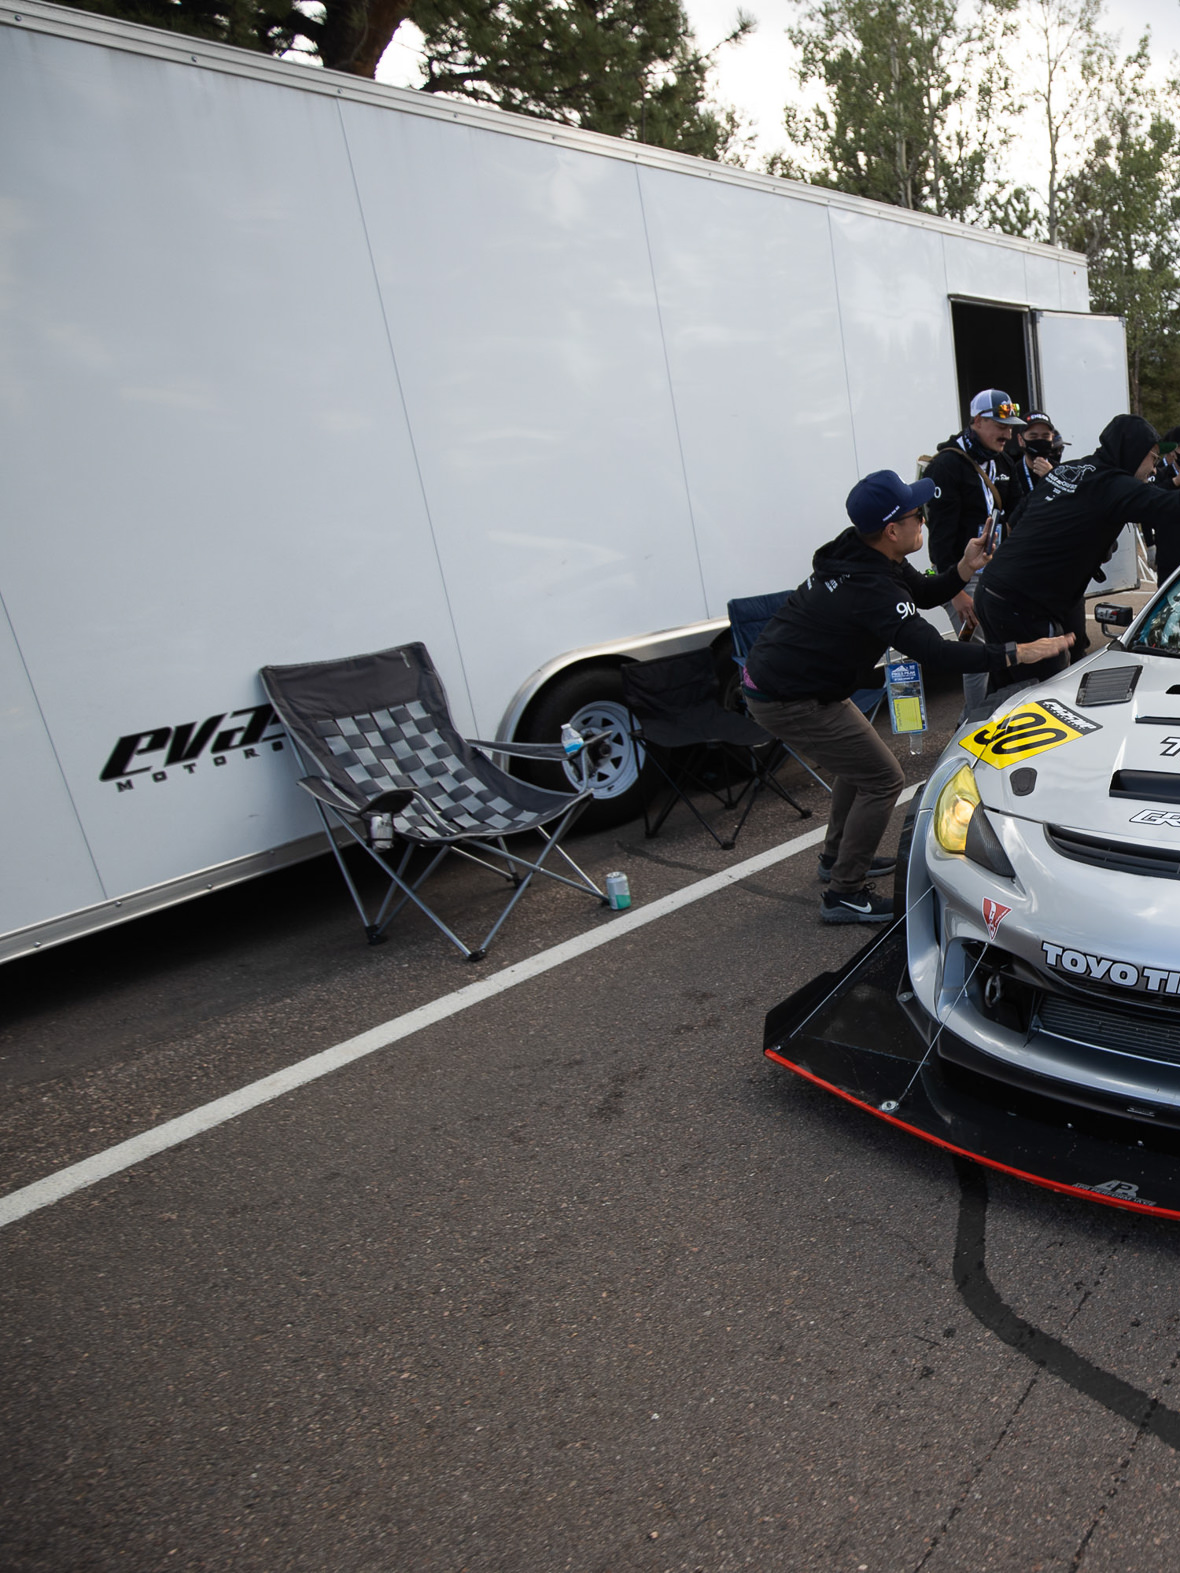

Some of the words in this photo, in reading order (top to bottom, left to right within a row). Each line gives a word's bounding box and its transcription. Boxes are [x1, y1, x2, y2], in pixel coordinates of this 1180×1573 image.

[896, 600, 916, 620] 90
[973, 712, 1068, 755] 90
[1042, 941, 1139, 987] TOYO
